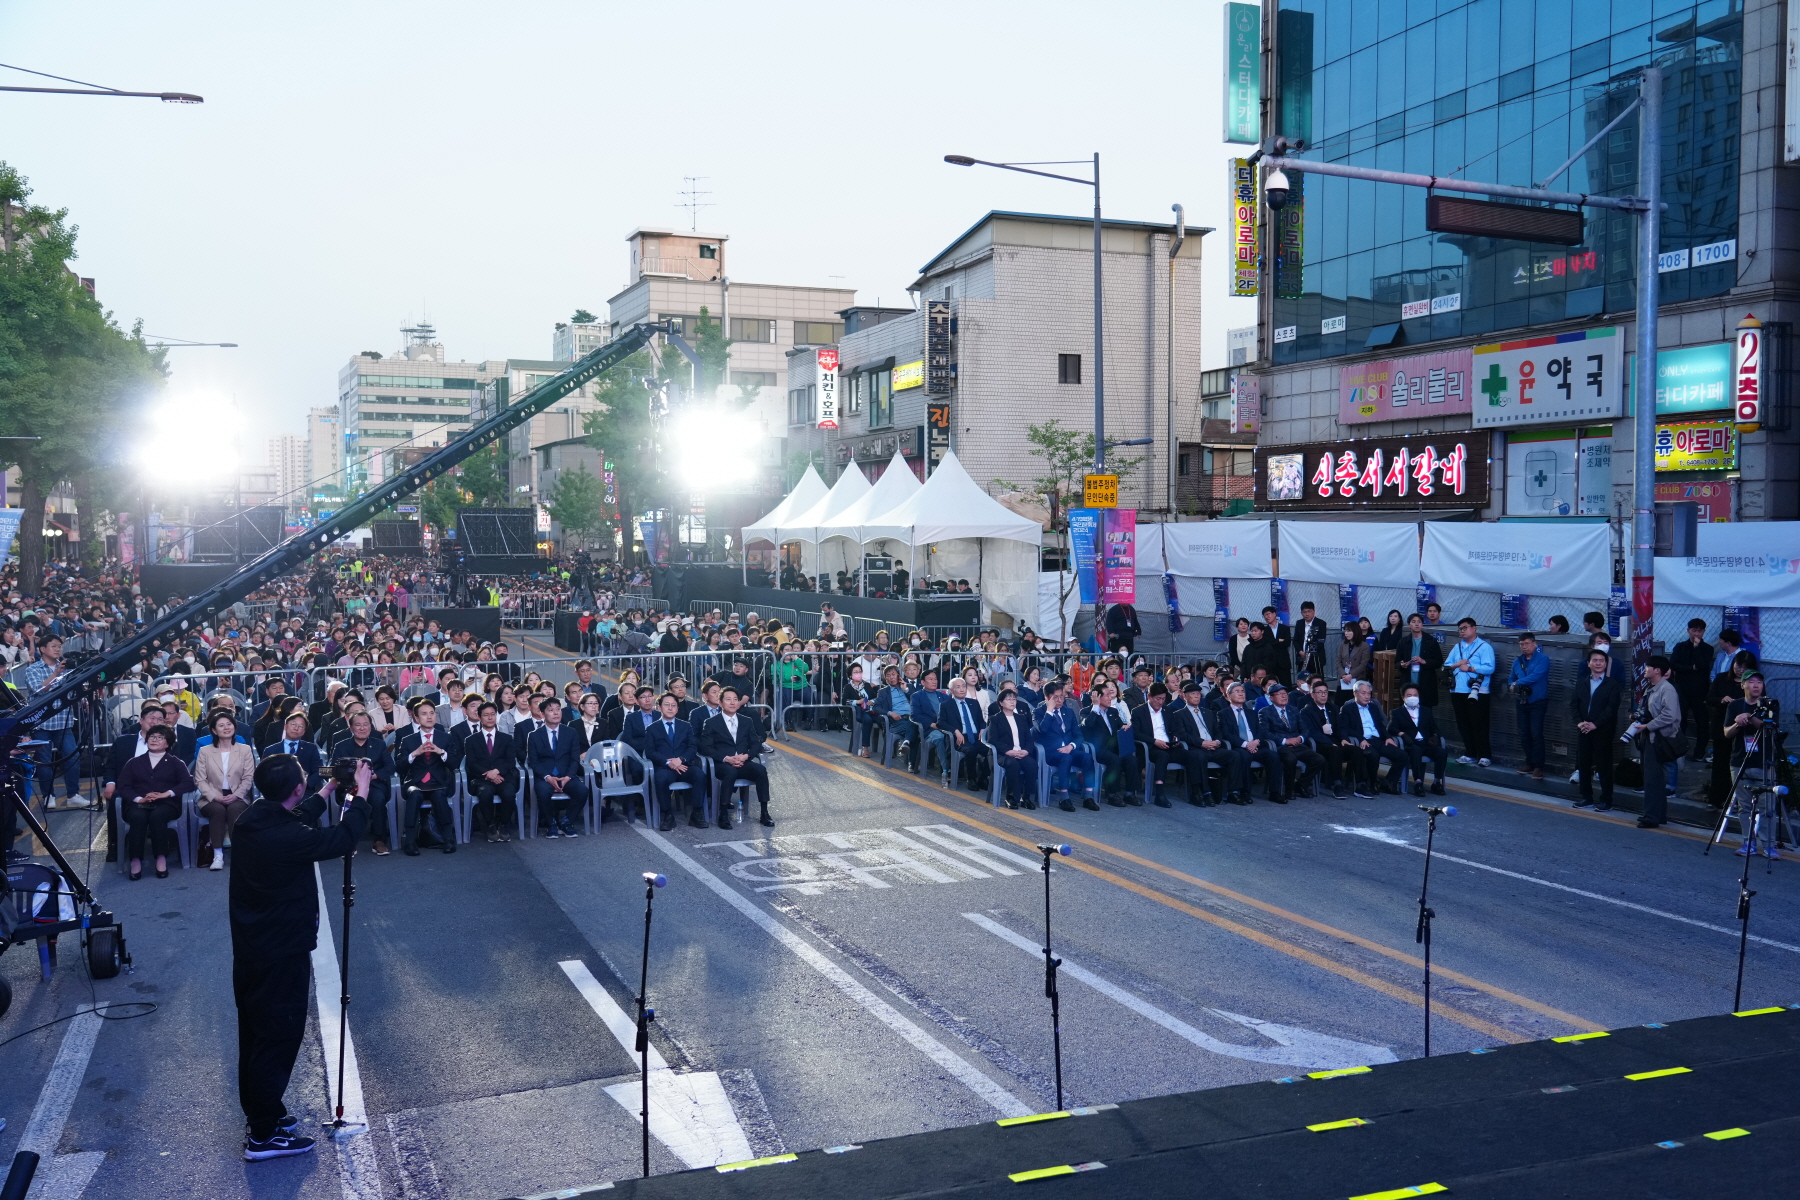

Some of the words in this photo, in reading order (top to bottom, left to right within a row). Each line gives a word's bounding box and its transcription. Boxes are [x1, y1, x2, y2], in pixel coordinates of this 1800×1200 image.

[1238, 54, 1252, 139] 스터디카페
[1237, 205, 1257, 267] 아로마
[1696, 243, 1730, 263] 1700
[1238, 279, 1255, 290] 2F
[929, 304, 950, 325] 수
[1323, 317, 1345, 331] 아로마
[1275, 326, 1296, 342] 스포츠
[1367, 371, 1389, 383] CLUB
[1518, 354, 1603, 405] 윤약국
[822, 373, 834, 418] 치킨&호프
[1348, 384, 1388, 403] 7080
[1391, 367, 1465, 408] 올리불리
[1676, 426, 1732, 455] 아로마
[1311, 443, 1467, 498] 신촌서서갈비
[1087, 479, 1116, 490] 불법주정차
[1660, 486, 1680, 495] CLUB
[1683, 485, 1721, 498] 7080
[1087, 492, 1116, 504] 무인단속중
